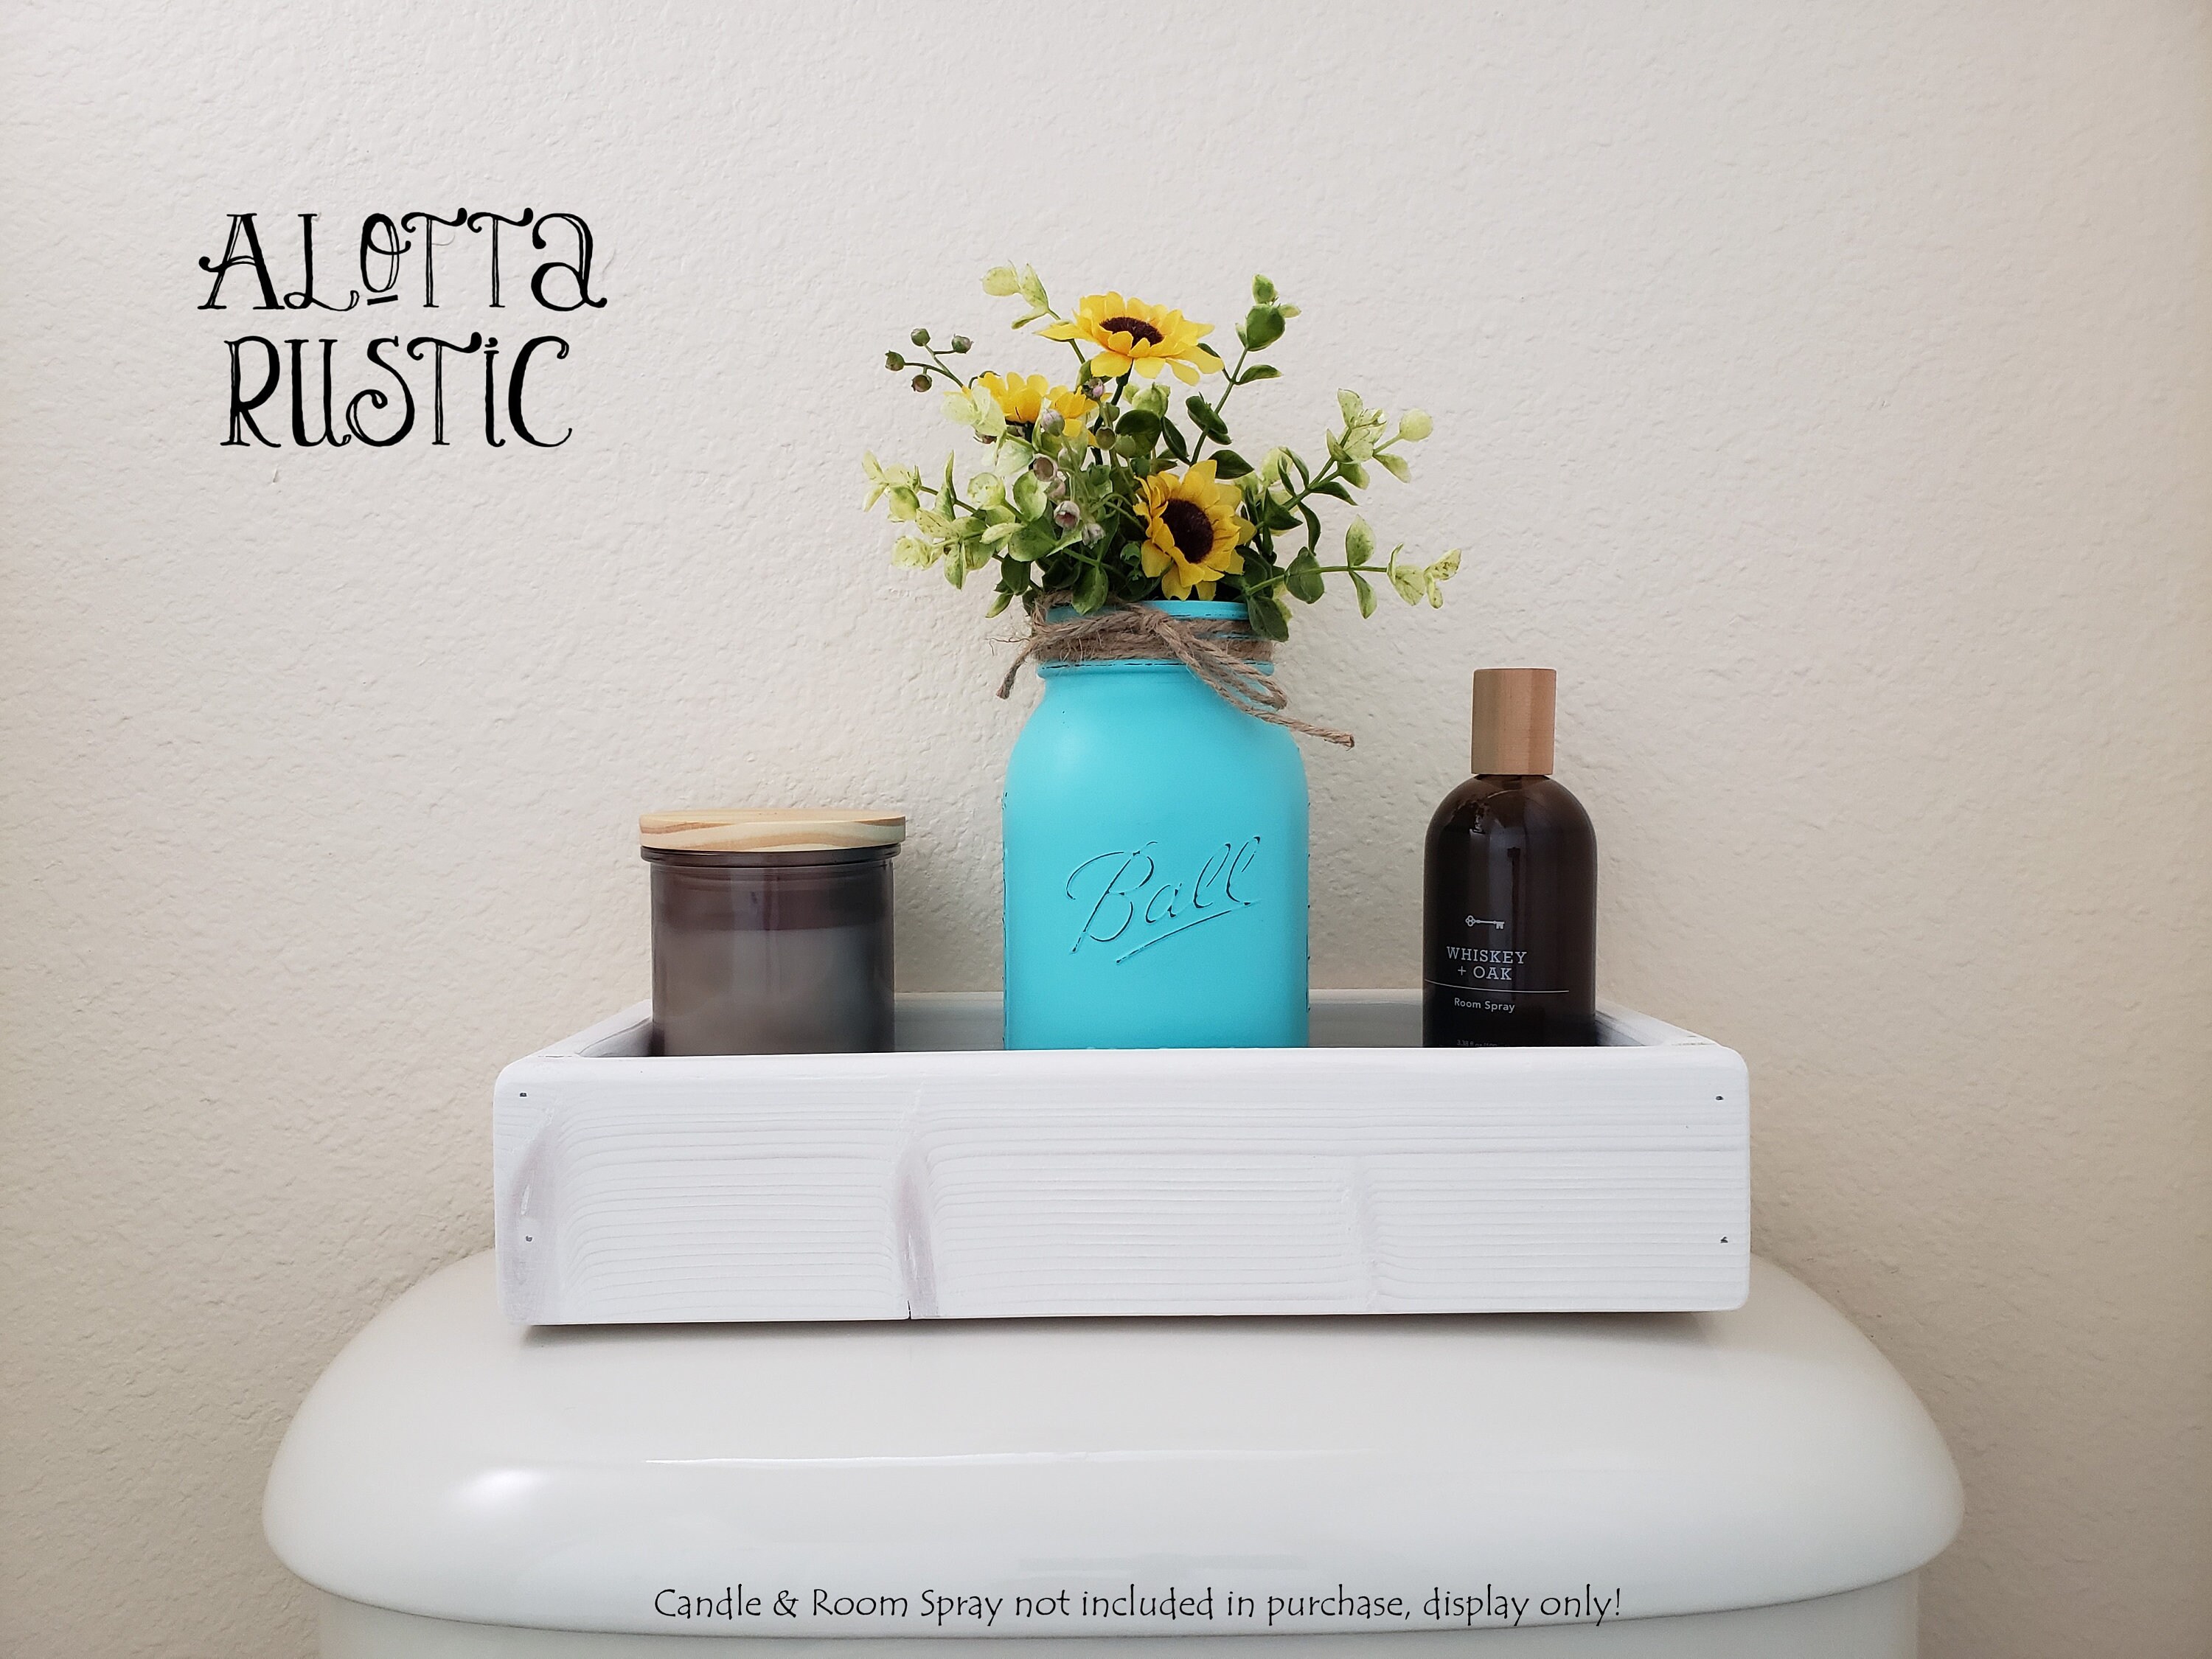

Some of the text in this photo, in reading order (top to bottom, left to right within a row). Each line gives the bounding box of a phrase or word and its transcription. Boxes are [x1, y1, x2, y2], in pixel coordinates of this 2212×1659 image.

[1065, 835, 1262, 956] Ball
[1446, 946, 1527, 964] WHISKEY
[1458, 966, 1512, 981] + OAK
[1454, 997, 1515, 1014] Room Spray
